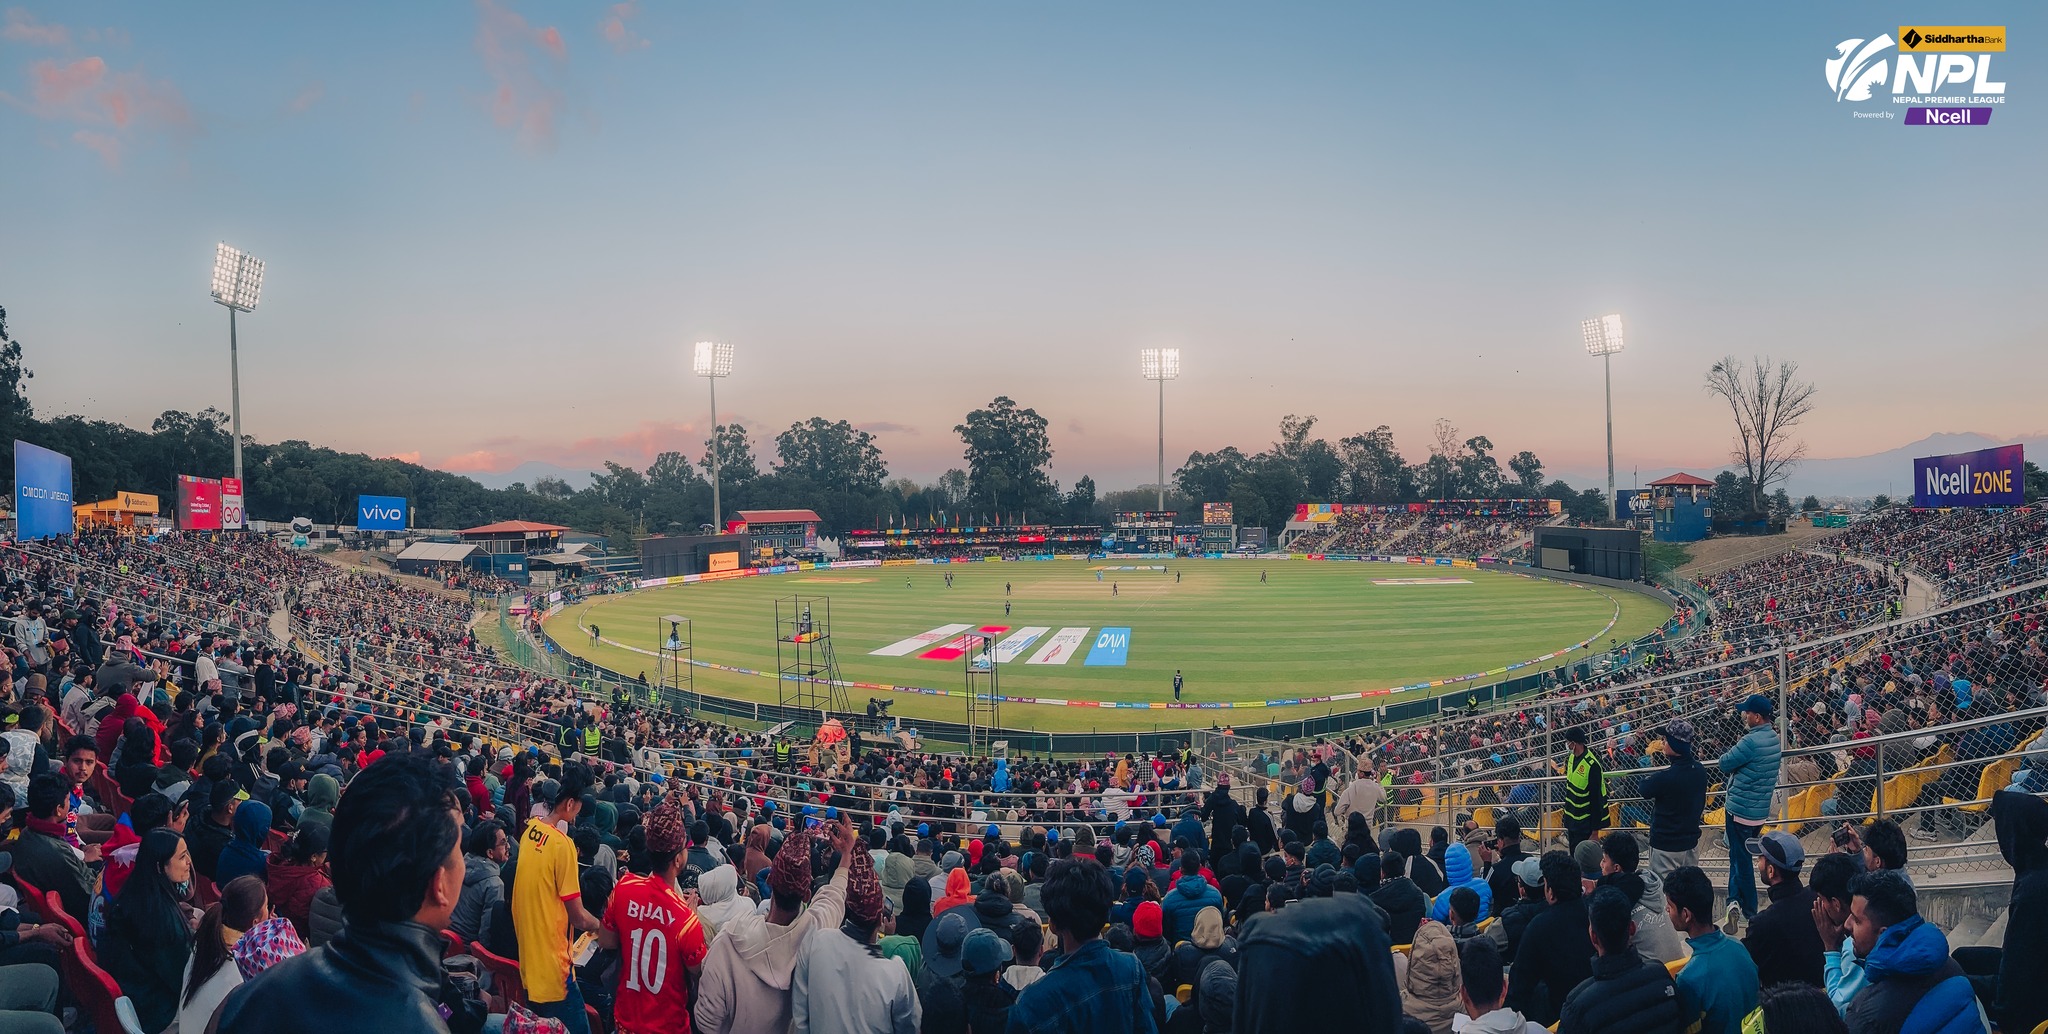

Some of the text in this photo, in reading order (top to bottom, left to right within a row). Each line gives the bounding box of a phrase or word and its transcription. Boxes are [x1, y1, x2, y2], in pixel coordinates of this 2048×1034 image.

[1926, 464, 2013, 495] Ncell ZONE
[362, 504, 401, 521] vivo
[1097, 633, 1126, 654] vivo
[627, 899, 676, 926] BIJAY
[626, 928, 667, 995] 10
